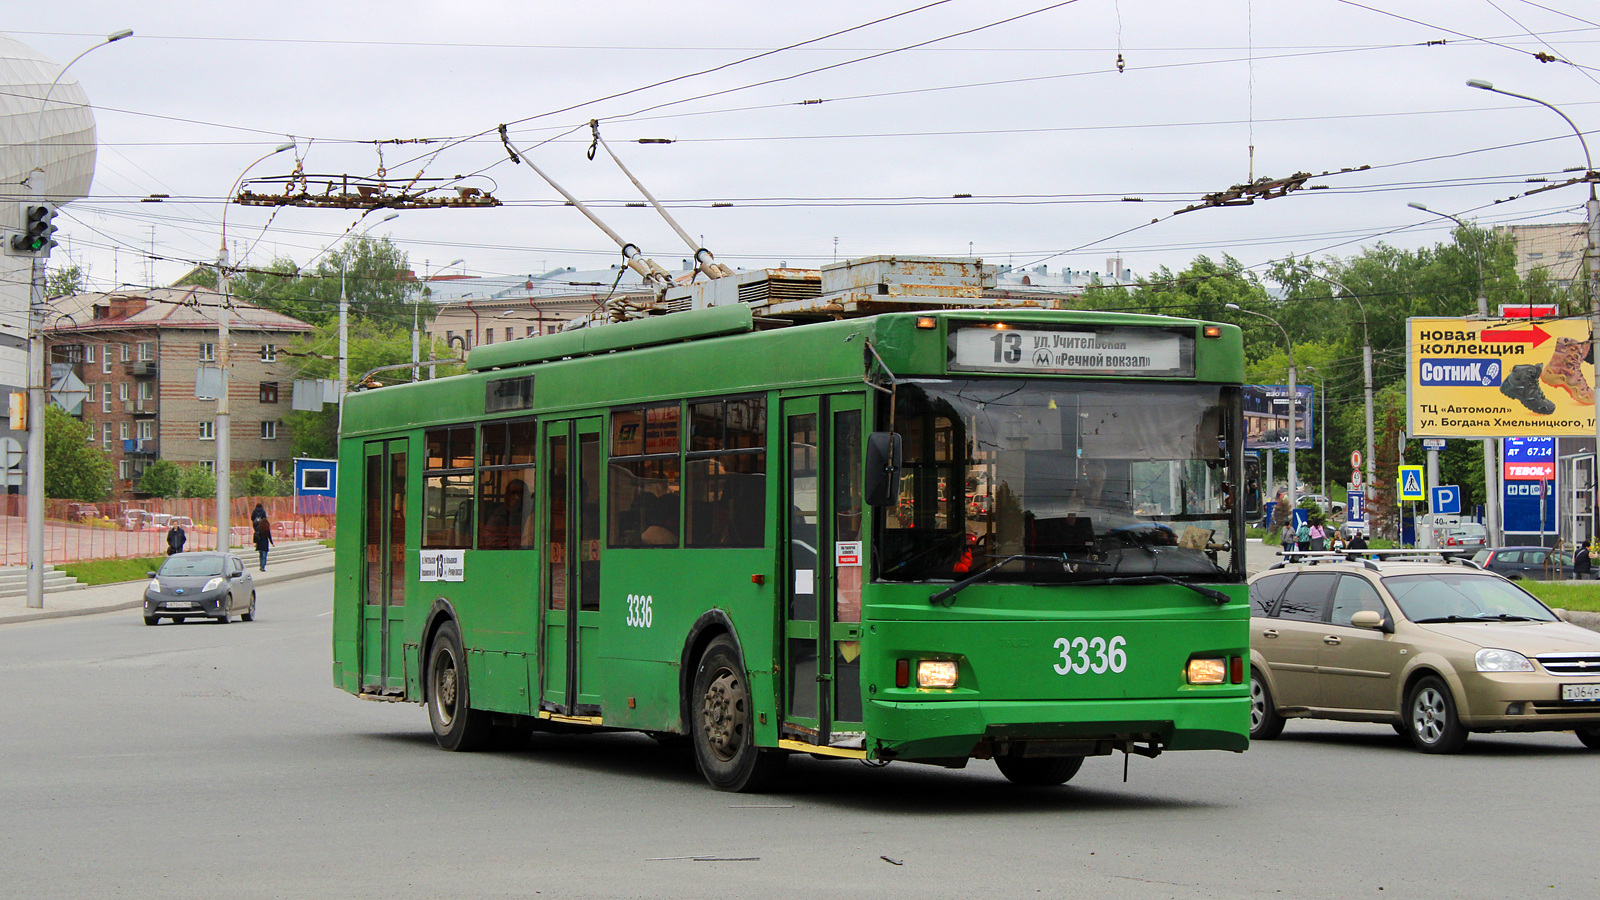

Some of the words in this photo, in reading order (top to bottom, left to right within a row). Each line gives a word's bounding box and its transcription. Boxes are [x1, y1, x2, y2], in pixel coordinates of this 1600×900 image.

[990, 333, 1022, 364] 13
[1033, 336, 1051, 350] ул.
[1055, 353, 1103, 367] «Речной
[1105, 355, 1151, 368] вокзал»
[1420, 405, 1438, 415] ТЦ
[1441, 405, 1512, 414] «Автомолл»
[1420, 419, 1437, 428] ул.
[1441, 418, 1490, 428] Богдана
[1494, 418, 1584, 429] Хмельницкого,
[1527, 447, 1552, 456] 67.14
[436, 554, 443, 577] 13
[626, 593, 653, 628] 3336
[1053, 635, 1127, 675] 3336
